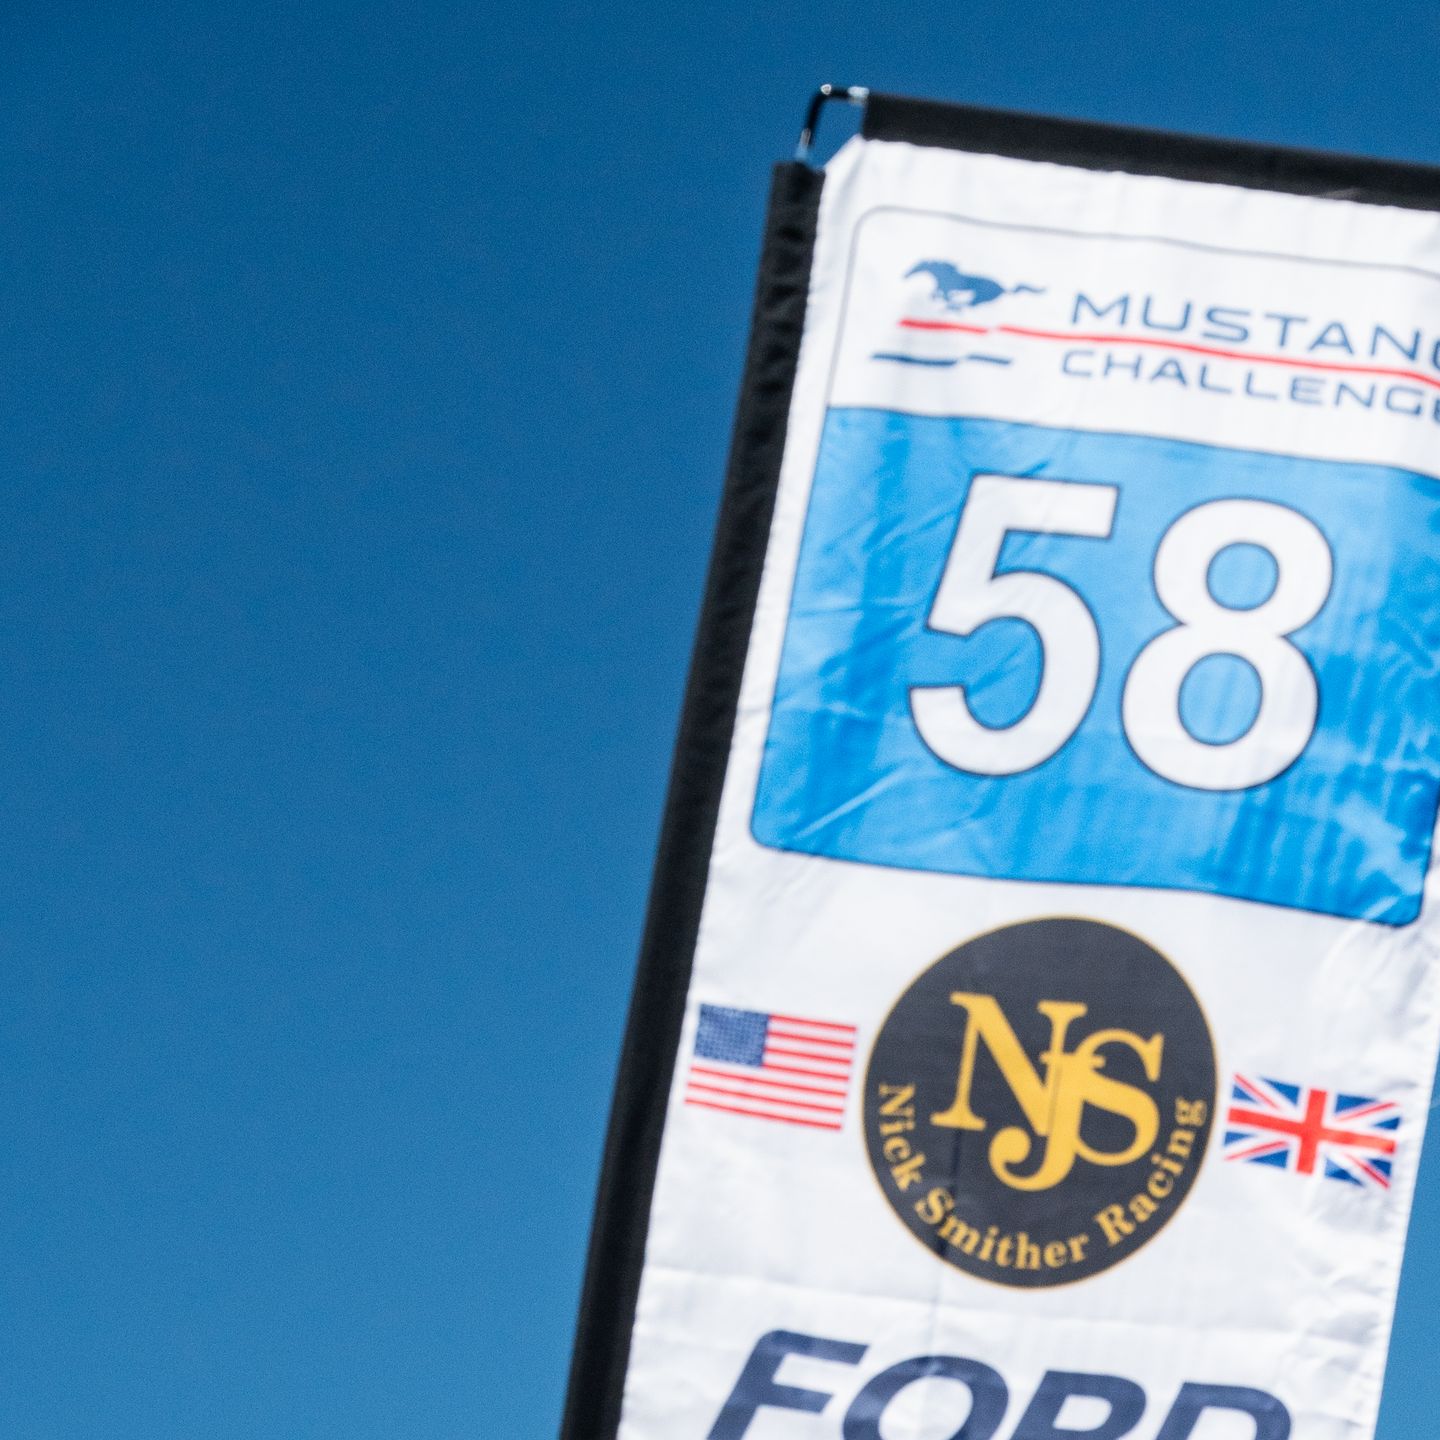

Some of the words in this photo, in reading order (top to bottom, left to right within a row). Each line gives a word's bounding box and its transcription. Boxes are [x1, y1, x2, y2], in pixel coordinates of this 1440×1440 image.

[909, 473, 1334, 791] 58
[876, 1080, 922, 1193] Nick
[916, 1187, 1091, 1271] Smither
[1097, 1097, 1208, 1247] Racing
